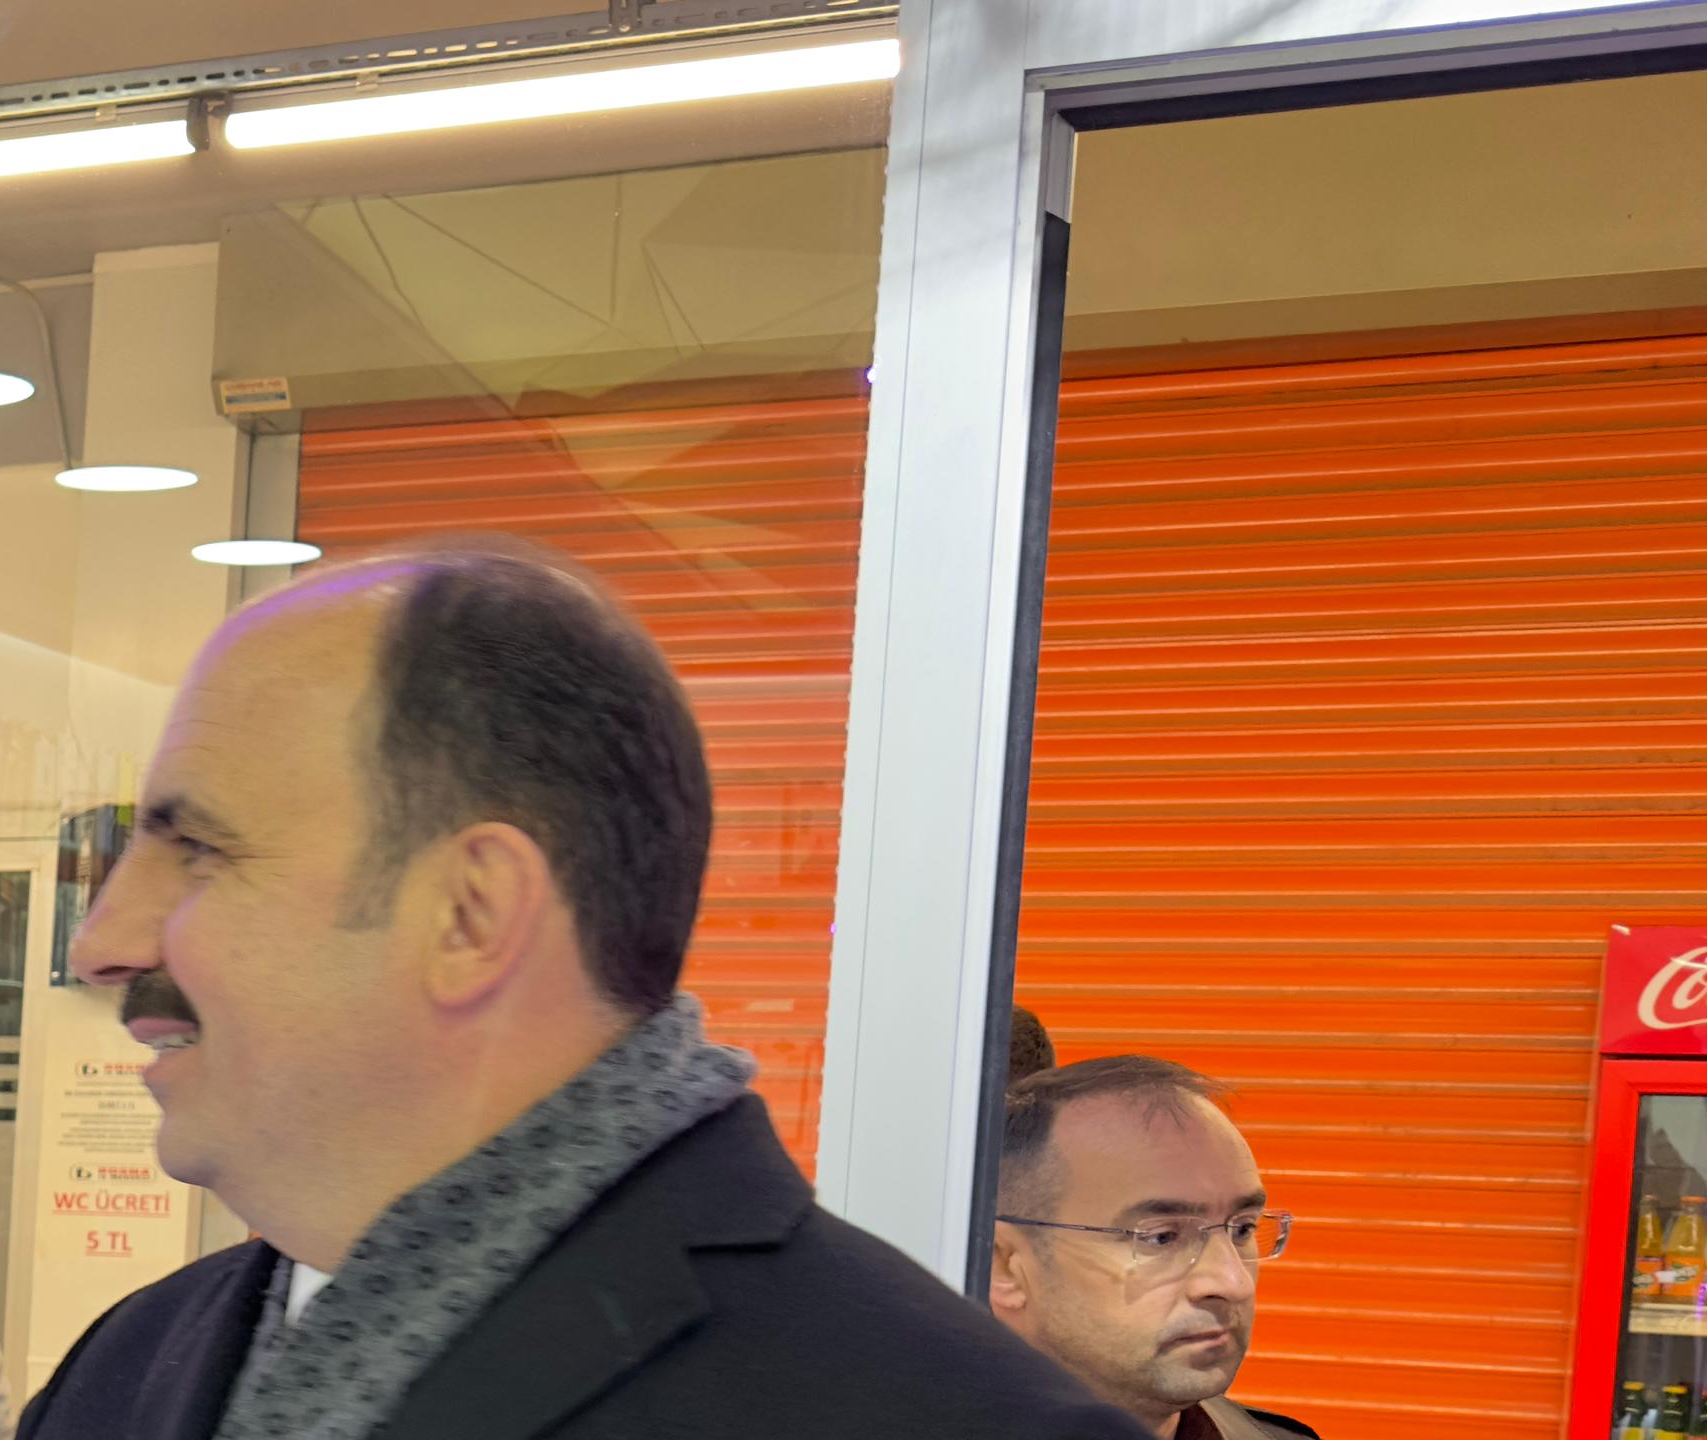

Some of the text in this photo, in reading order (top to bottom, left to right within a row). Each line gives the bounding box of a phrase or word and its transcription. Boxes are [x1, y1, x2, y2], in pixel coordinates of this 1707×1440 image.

[53, 1188, 171, 1213] WC ÜCRETİ
[86, 1230, 133, 1251] 5 TL
